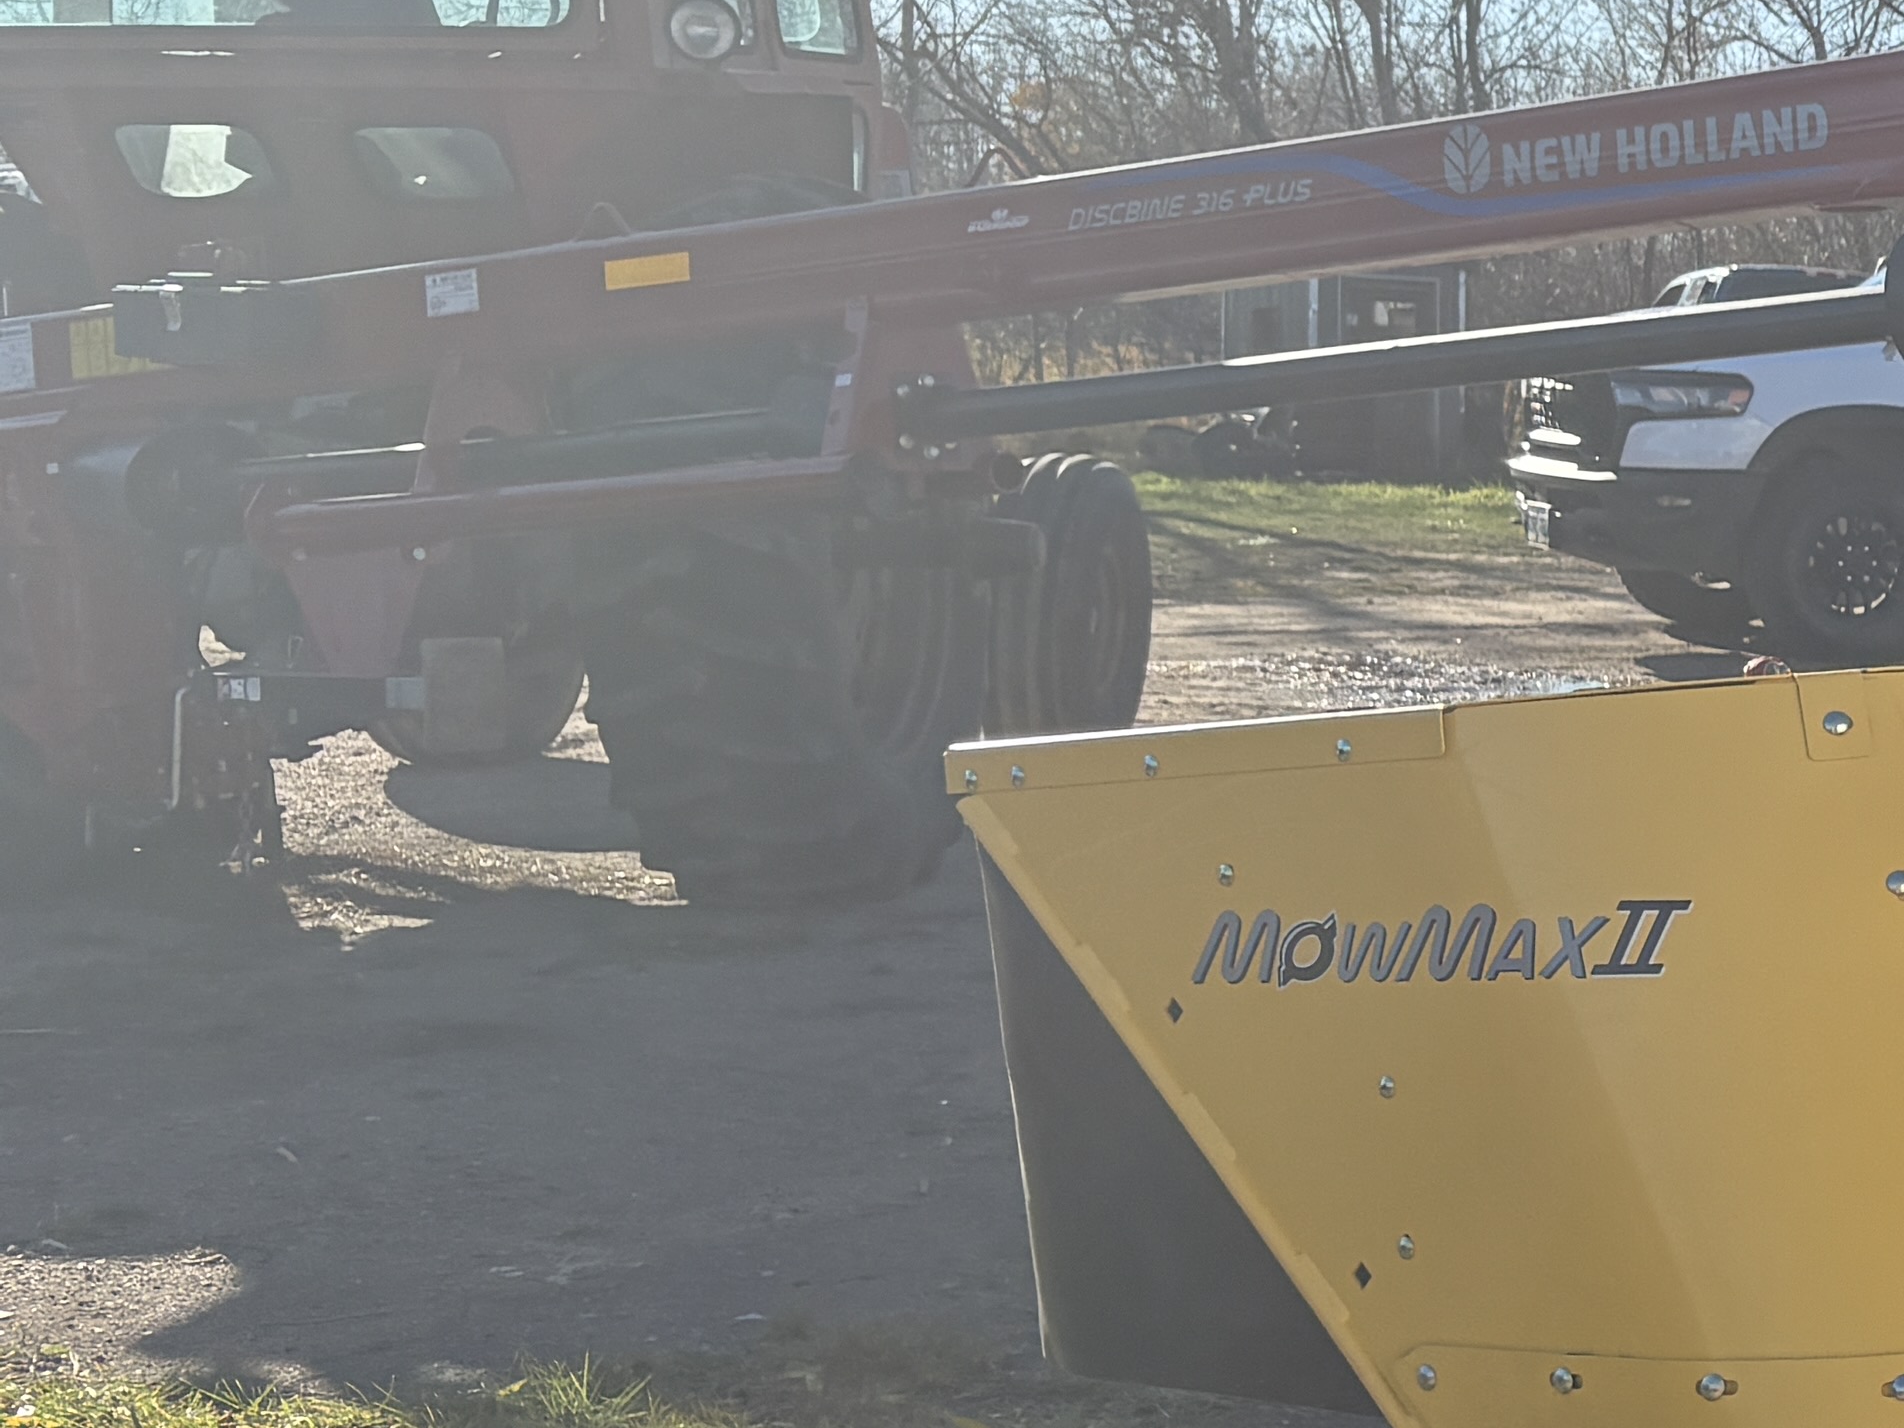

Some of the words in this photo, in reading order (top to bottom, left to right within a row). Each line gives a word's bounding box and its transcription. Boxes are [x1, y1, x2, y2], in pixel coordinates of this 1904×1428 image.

[1502, 131, 1601, 188] NEW
[1616, 102, 1829, 173] HOLLAND
[1068, 195, 1186, 231] DISCBINE
[1192, 188, 1236, 216] 316
